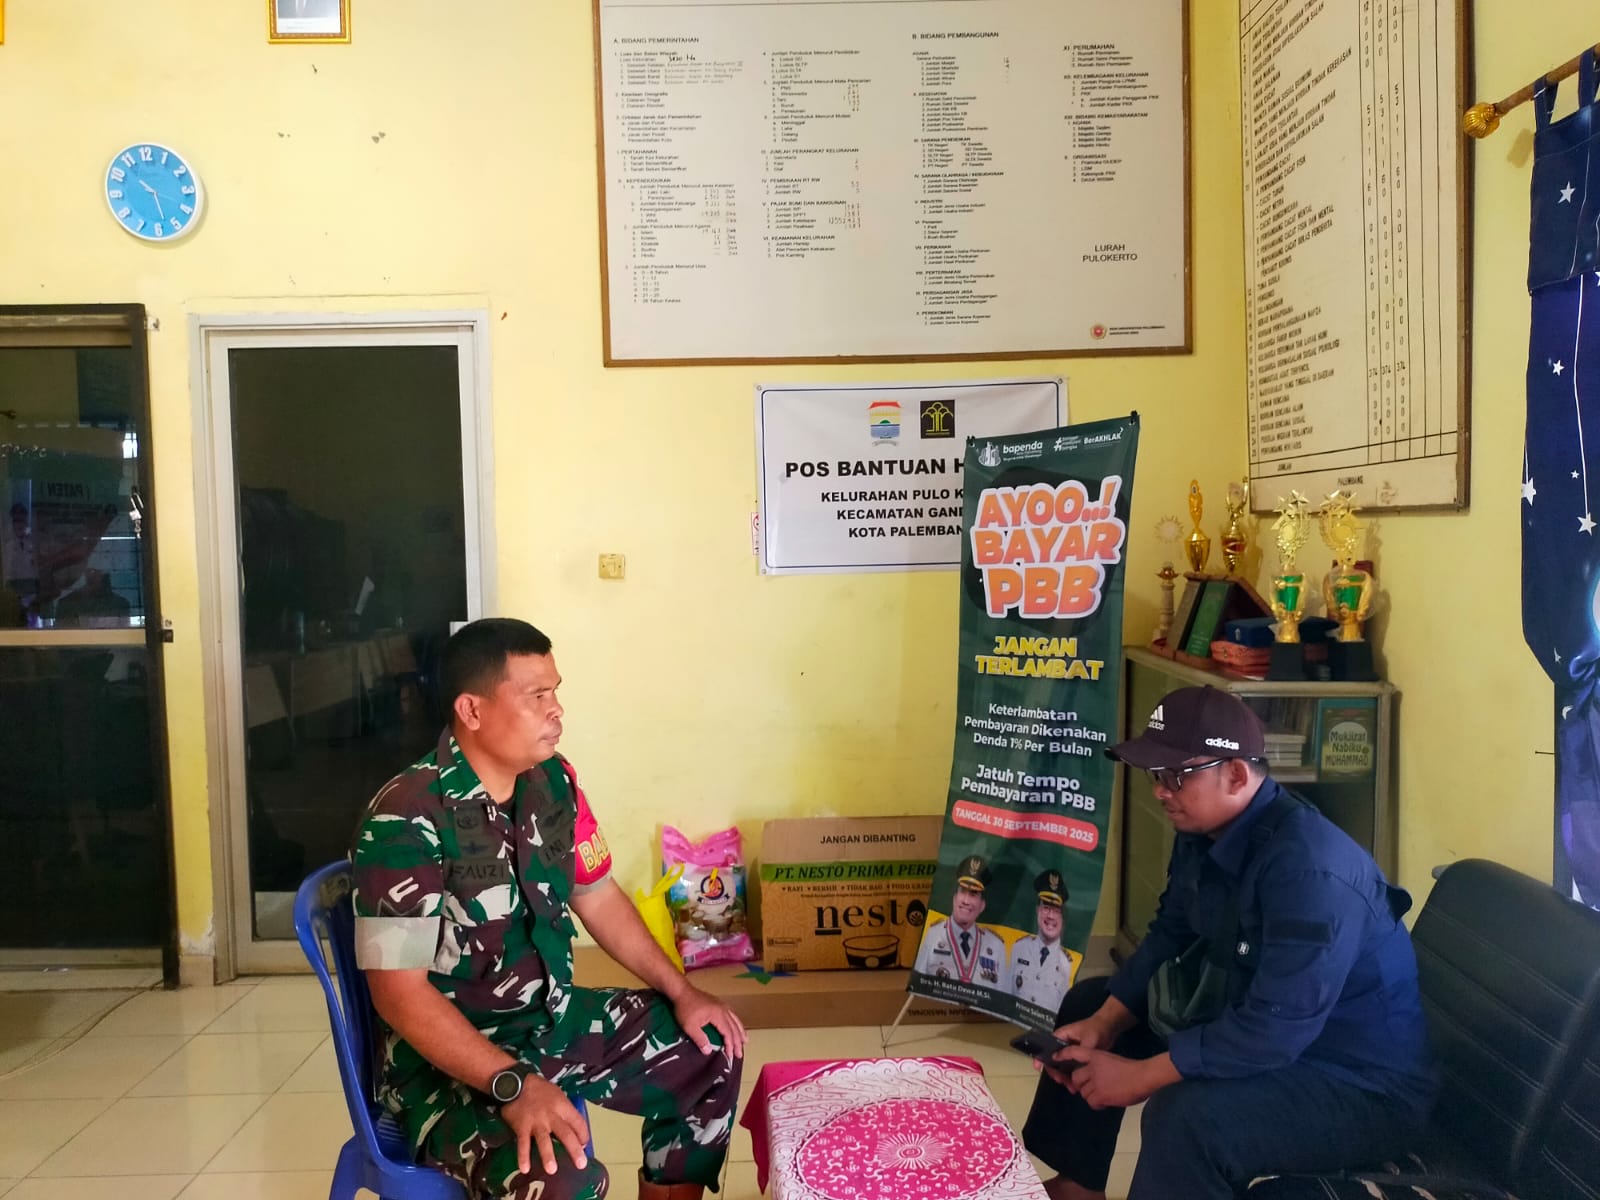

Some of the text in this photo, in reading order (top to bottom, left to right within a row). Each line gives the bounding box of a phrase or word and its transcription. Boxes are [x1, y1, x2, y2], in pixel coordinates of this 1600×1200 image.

[121, 151, 136, 168] 11
[139, 146, 153, 162] 12
[160, 151, 169, 165] 1
[110, 166, 126, 183] 10
[173, 165, 187, 178] 2
[109, 189, 123, 199] 9
[180, 185, 195, 195] 3
[118, 206, 131, 219] 8
[179, 203, 193, 215] 4
[135, 218, 145, 232] 7
[154, 222, 163, 237] 6
[170, 216, 182, 230] 5
[1094, 243, 1126, 252] LURAH
[1082, 253, 1138, 263] PULOKERTO
[1083, 433, 1121, 445] BerAKHLAK
[1002, 440, 1043, 455] bapenda
[785, 462, 830, 479] POS
[837, 458, 946, 477] BANTUAN
[820, 488, 964, 503] KELURAHAN PULO K
[836, 508, 924, 520] KECAMATAN
[848, 527, 887, 538] KOTA
[970, 518, 1125, 568] BAYAR
[982, 560, 1105, 618] PBB
[993, 635, 1078, 657] JANGAN
[975, 654, 1104, 681] TERLAMBAT
[989, 703, 1078, 721] Keterlambatan
[964, 715, 1107, 742] Pembayaran Dikenakan
[973, 732, 1093, 757] Denda 1% Per Bulan
[1205, 737, 1240, 751] adidas
[1331, 743, 1362, 753] Nabiku
[976, 764, 1081, 791] Jatuh Tempo
[961, 776, 1096, 812] Pembayaran PBB
[955, 807, 1094, 843] TANGGAL 30 SEPTEMBER 2025
[820, 833, 916, 845] JANGAN DIBANTING
[449, 863, 504, 879] FAUZI
[774, 867, 795, 880] PT.
[797, 865, 844, 879] NESTO
[847, 864, 894, 878] PRIMA
[814, 898, 926, 928] nesto
[957, 984, 976, 995] Dewa
